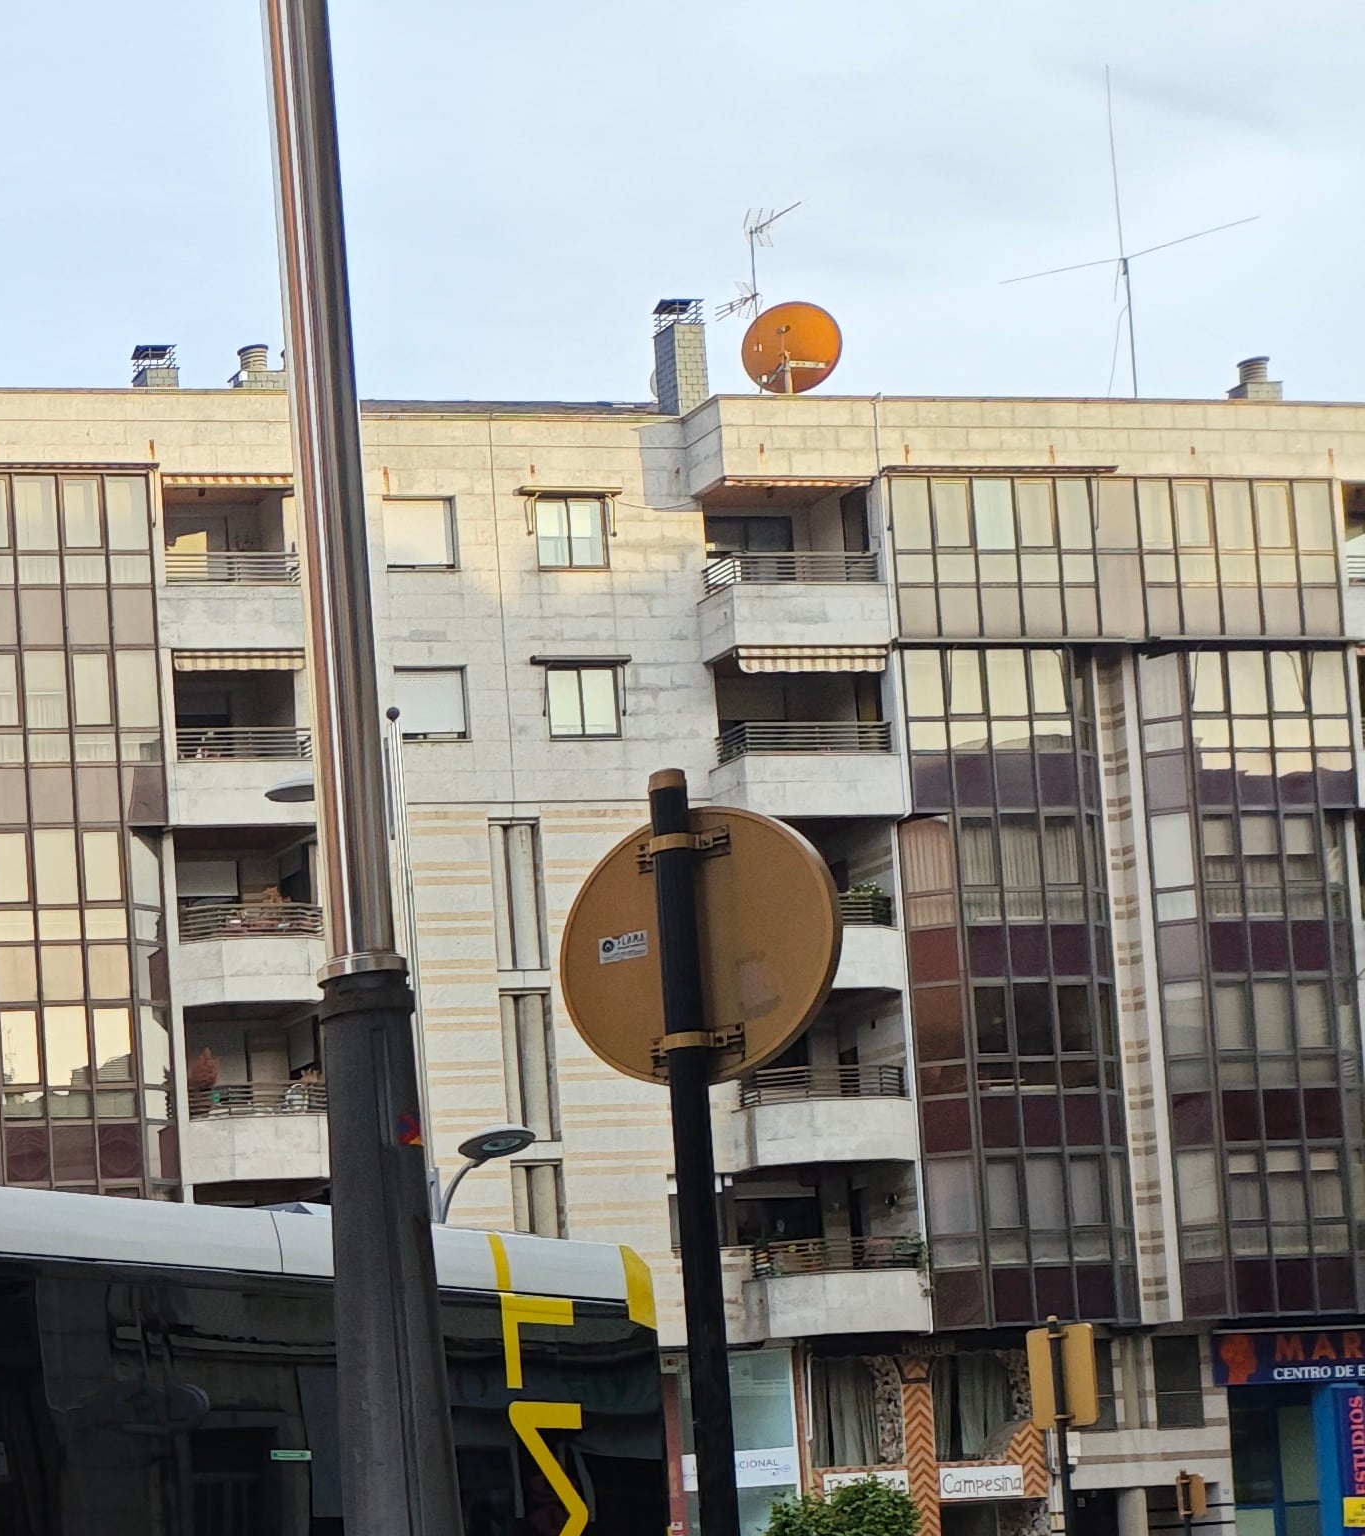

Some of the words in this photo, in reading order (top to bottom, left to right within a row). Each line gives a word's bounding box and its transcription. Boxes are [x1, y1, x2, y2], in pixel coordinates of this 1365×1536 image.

[1273, 1365, 1332, 1380] CENTRO
[1335, 1364, 1355, 1378] DE
[942, 1473, 1022, 1495] Campesina
